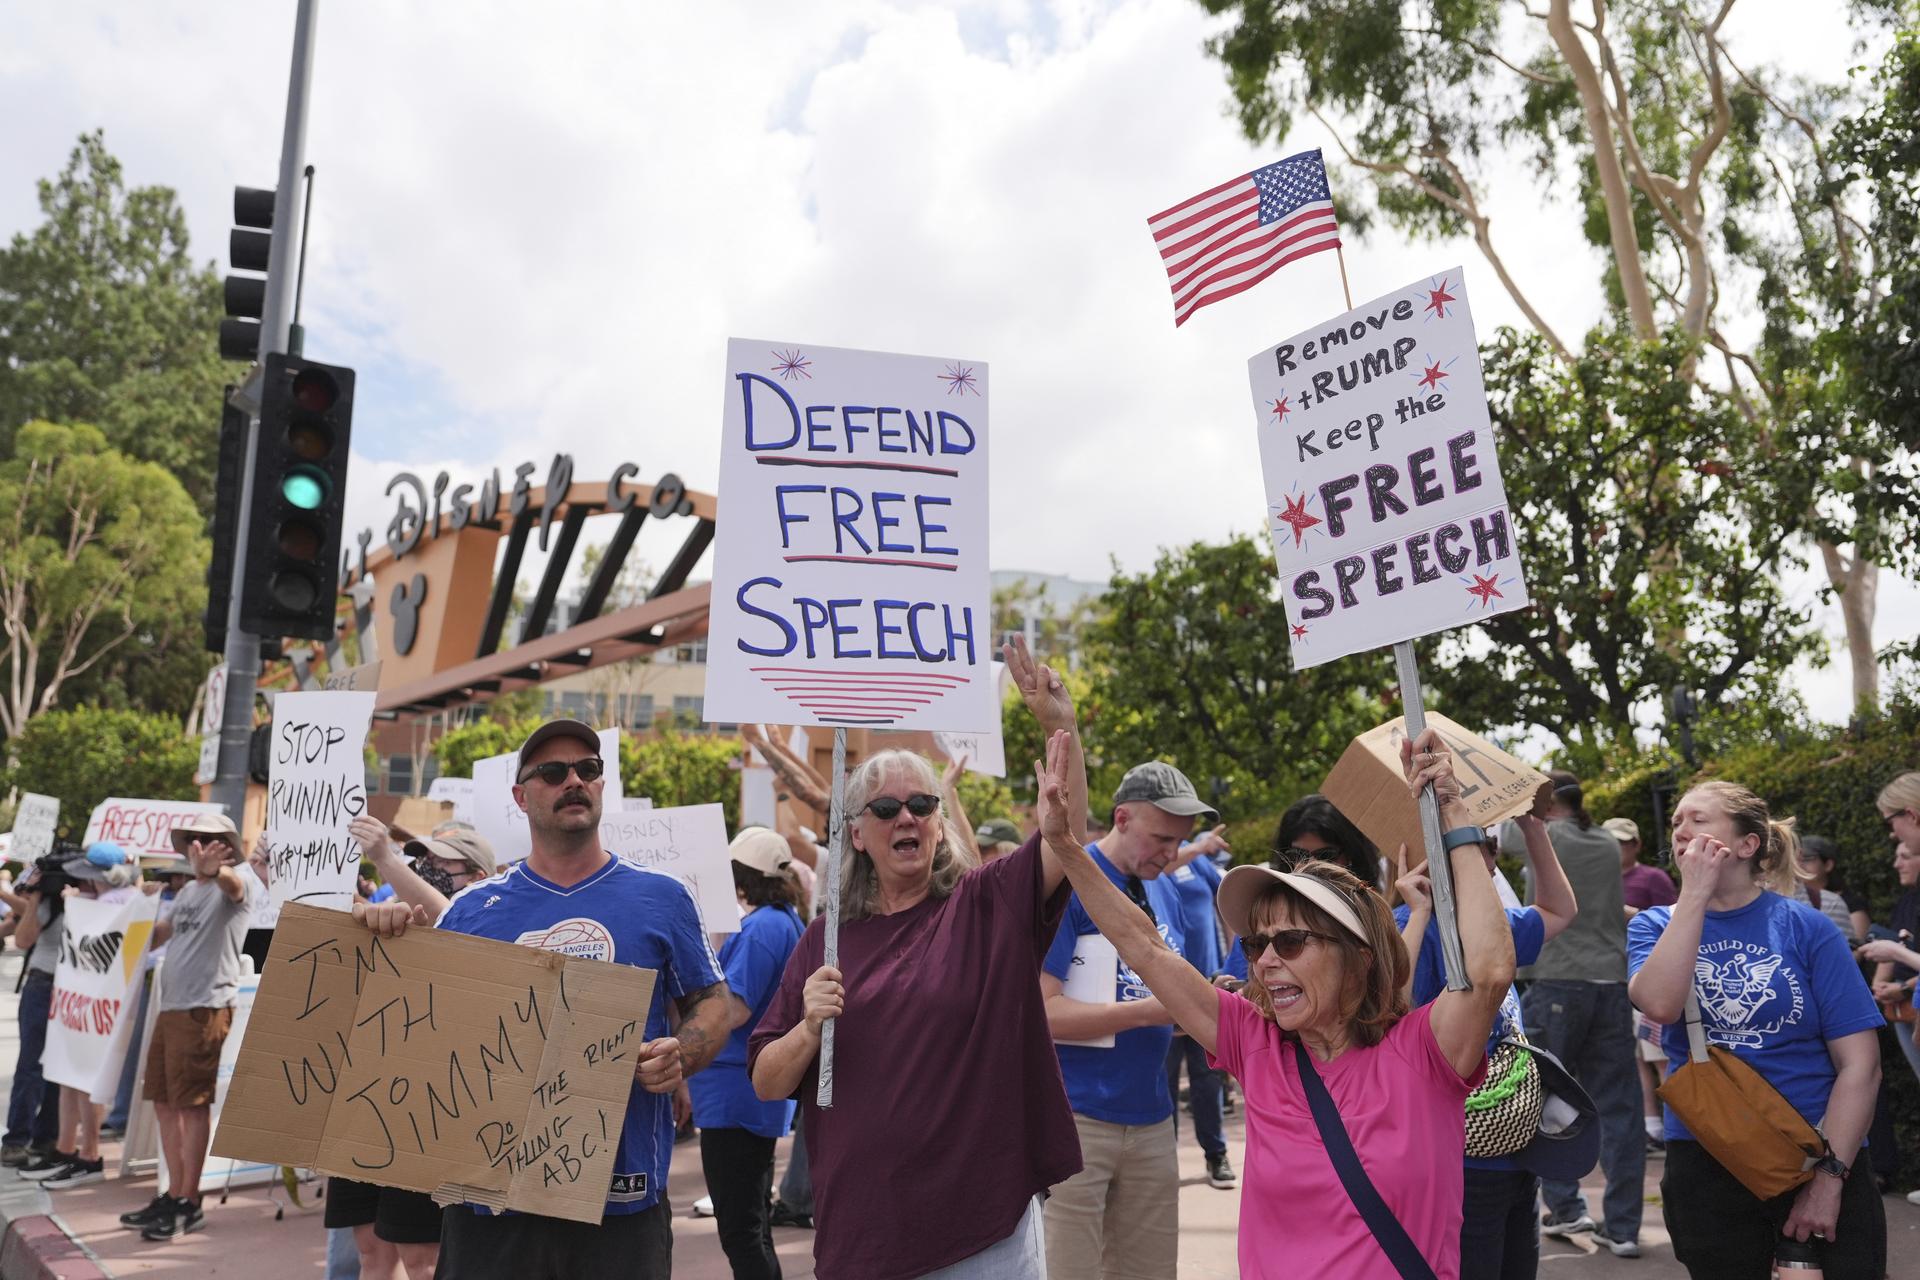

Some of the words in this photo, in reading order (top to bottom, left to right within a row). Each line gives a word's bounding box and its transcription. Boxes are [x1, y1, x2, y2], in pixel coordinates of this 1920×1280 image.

[1275, 299, 1414, 376] Remove
[736, 372, 976, 456] DEFEND
[1297, 413, 1384, 462] Keep
[1395, 393, 1446, 424] the
[1319, 429, 1482, 538] FREE
[776, 484, 958, 556] FREE
[1293, 509, 1511, 620] SPEECH
[736, 576, 976, 665] SPEECH
[278, 720, 346, 766] STOP
[270, 771, 365, 831] RUINING
[601, 815, 675, 848] DISNEY
[268, 837, 362, 891] EVERYTHING
[289, 936, 401, 1020] I'M
[563, 943, 605, 954] ANGELES
[1698, 939, 1743, 955] GUILD
[1745, 943, 1769, 956] OF
[1780, 967, 1804, 1026] AMERICA
[282, 982, 437, 1105] WITH
[1720, 1033, 1749, 1042] WEST
[533, 1070, 570, 1109] THE
[491, 1116, 573, 1174] THING
[543, 1109, 608, 1188] ABC!
